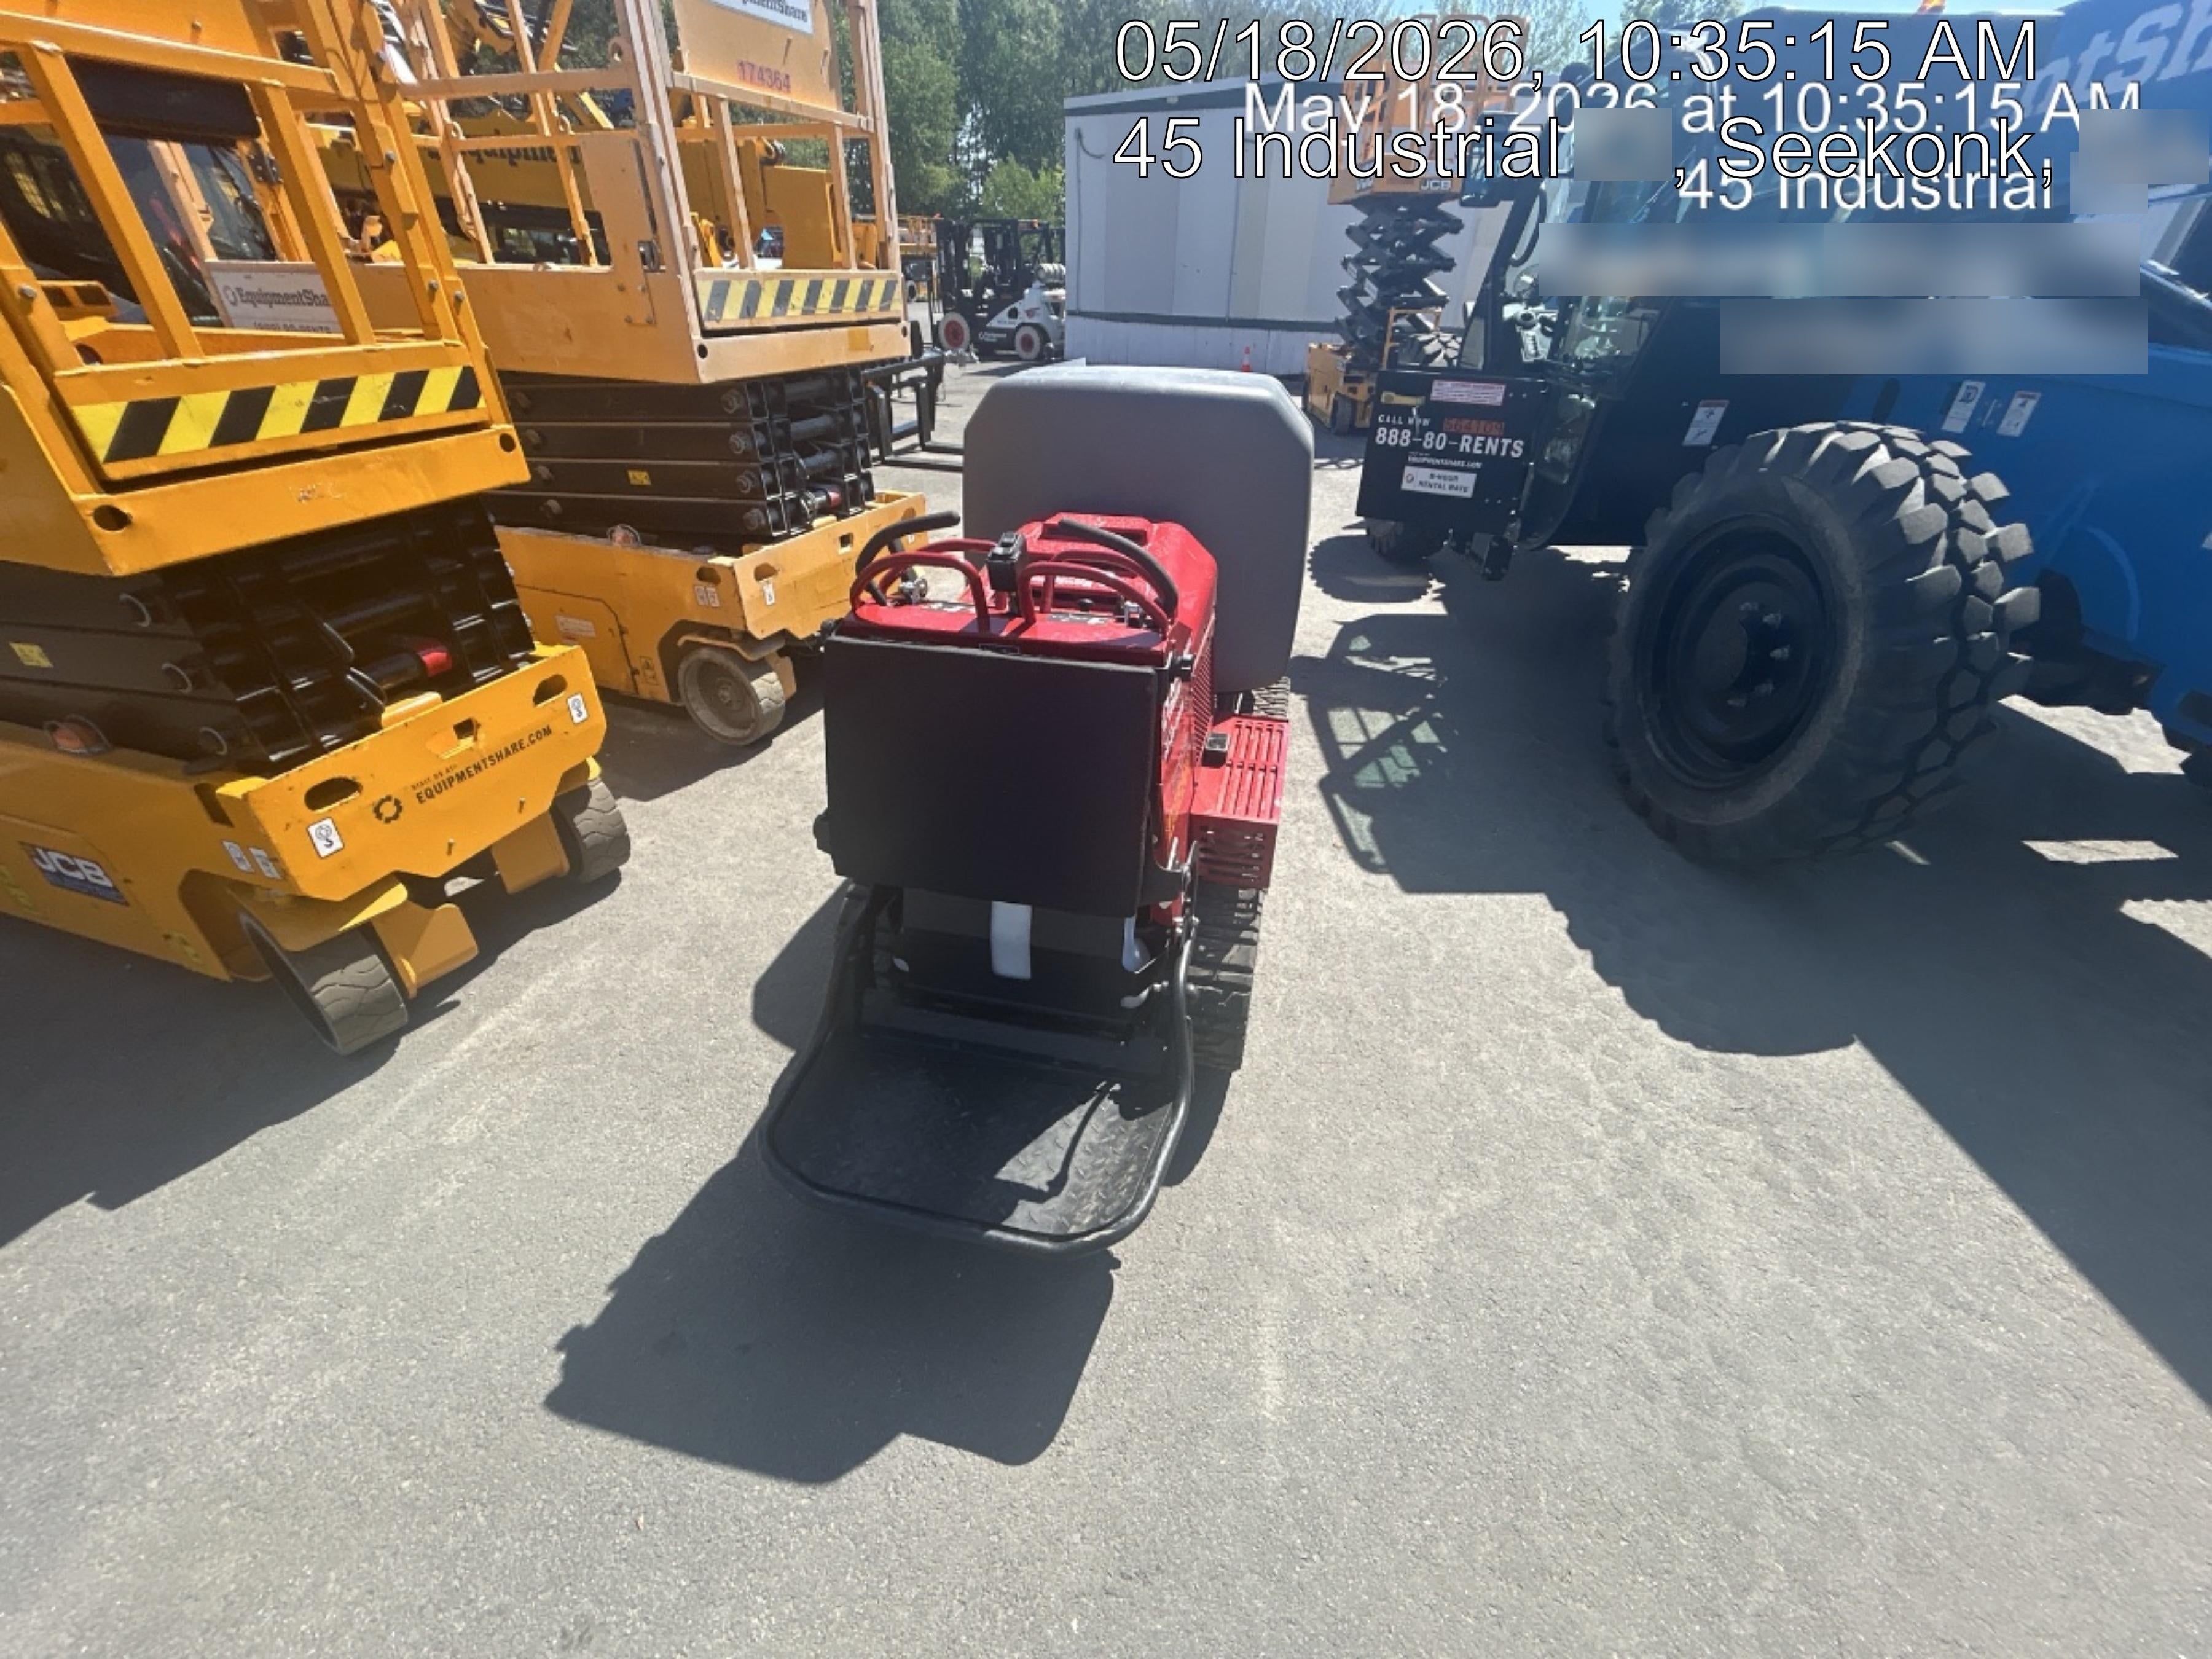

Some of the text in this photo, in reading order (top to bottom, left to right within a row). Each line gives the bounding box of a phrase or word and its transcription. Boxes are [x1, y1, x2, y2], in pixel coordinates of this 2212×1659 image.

[1421, 179, 1451, 190] JCB
[1375, 427, 1524, 458] 888-80-RENTS
[415, 725, 552, 804] EQUIPMENTSHARE.COM
[34, 847, 114, 888] JCB
